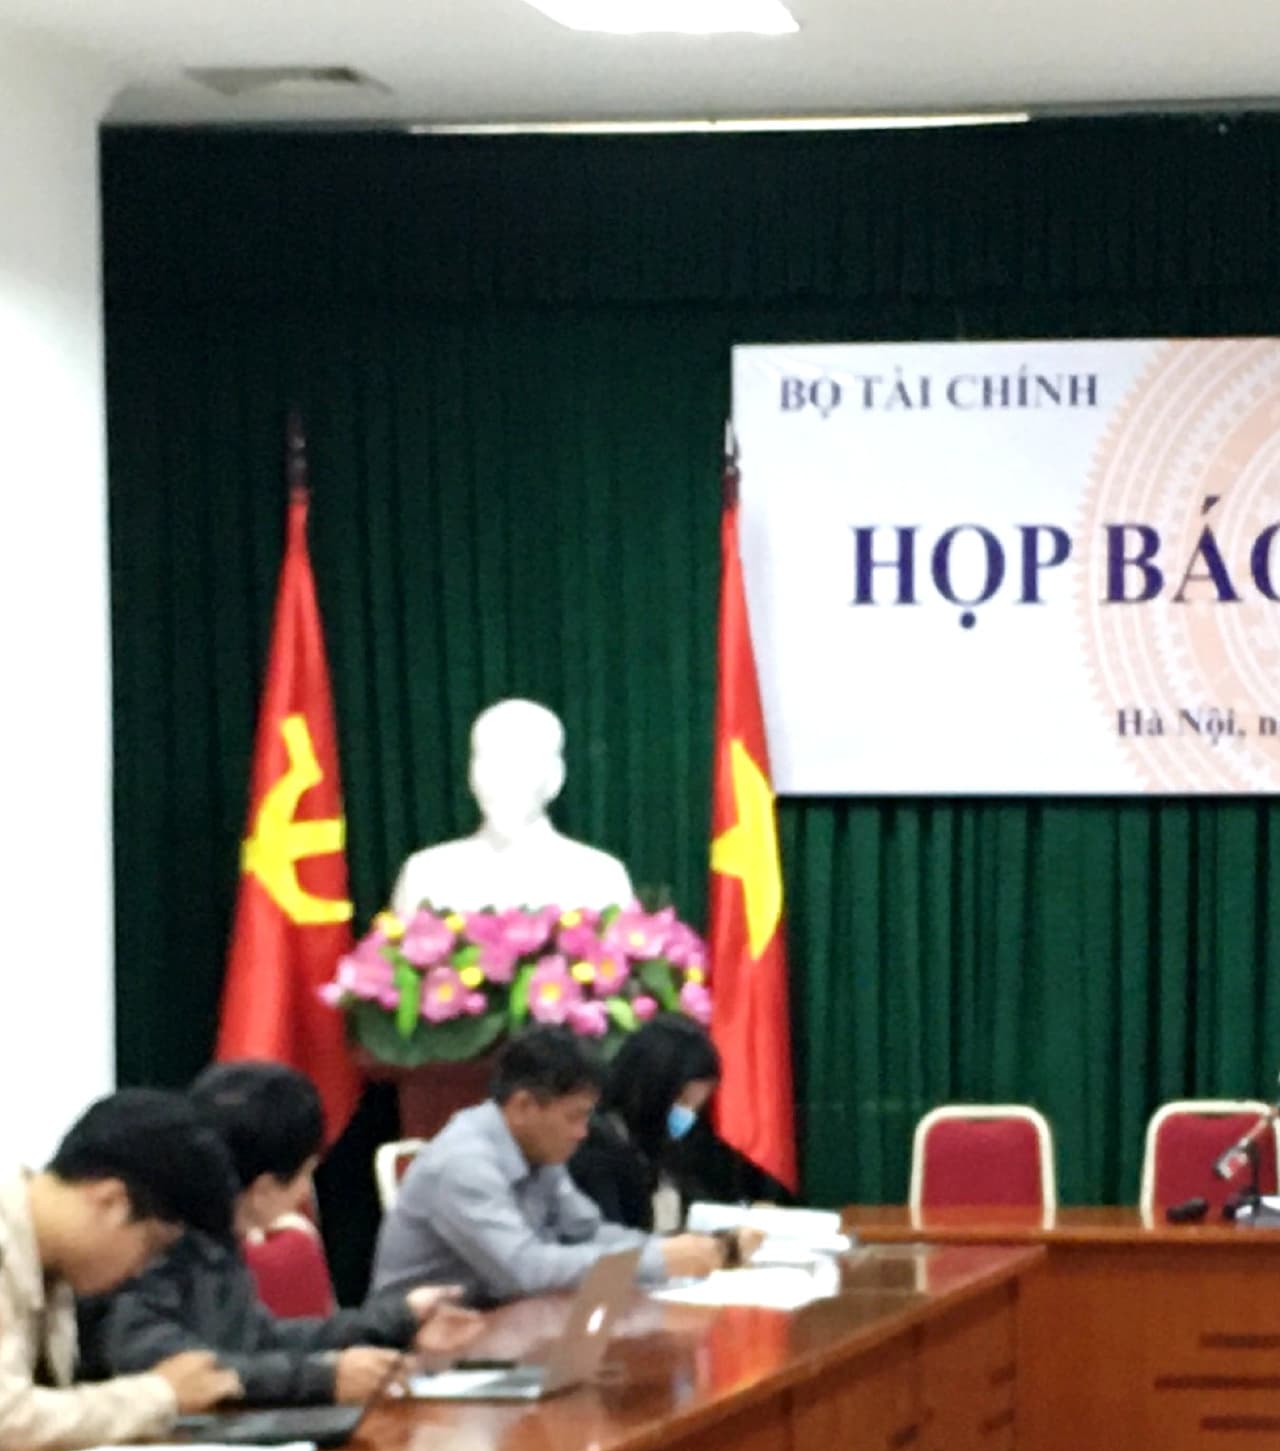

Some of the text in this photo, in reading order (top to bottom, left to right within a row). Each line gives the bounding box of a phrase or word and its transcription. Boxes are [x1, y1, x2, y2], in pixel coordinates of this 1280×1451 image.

[855, 363, 931, 411] TÀI
[945, 363, 1098, 410] CHÍNH
[849, 522, 1073, 629] HỌP
[1117, 707, 1164, 736] Hà
[1176, 707, 1247, 745] Nội,
